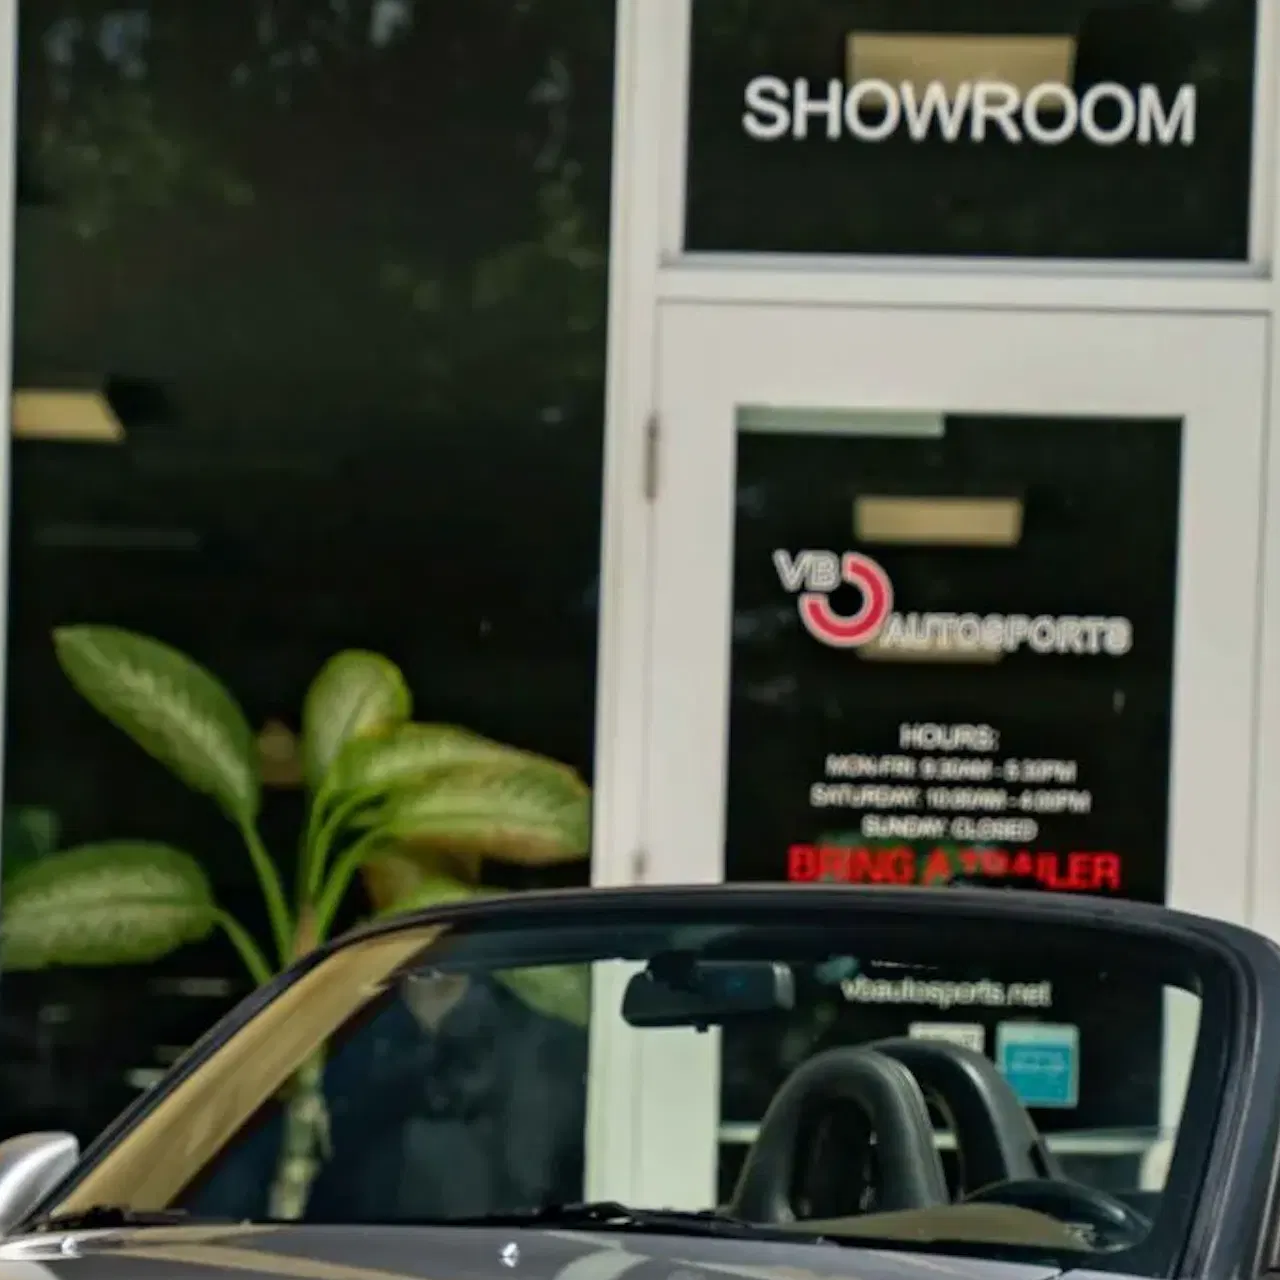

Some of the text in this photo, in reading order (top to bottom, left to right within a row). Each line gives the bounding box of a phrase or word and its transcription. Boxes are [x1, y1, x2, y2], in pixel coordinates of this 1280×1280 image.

[742, 76, 1196, 146] SHOWROOM
[773, 549, 841, 592] VB
[880, 611, 1133, 654] AUTOSPORTS
[788, 845, 915, 883] BRING
[923, 847, 954, 886] A
